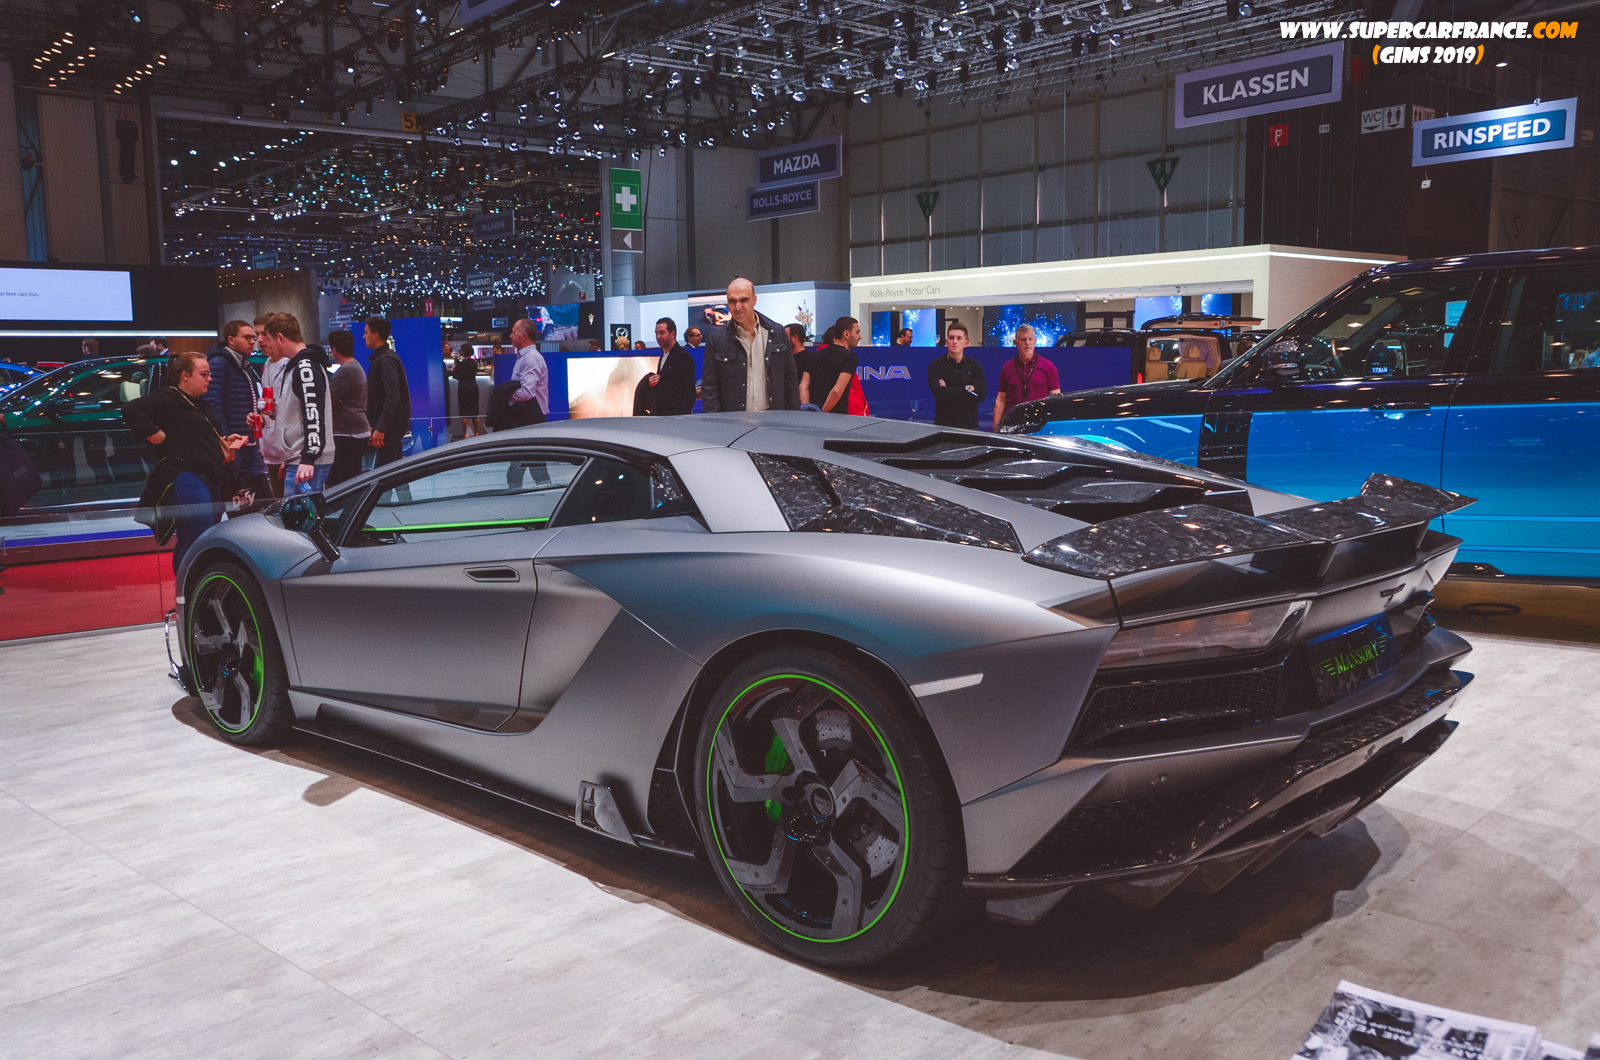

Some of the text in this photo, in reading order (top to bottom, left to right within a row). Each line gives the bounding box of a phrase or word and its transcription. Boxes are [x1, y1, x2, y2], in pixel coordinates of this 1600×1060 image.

[1203, 67, 1309, 105] KLASSEN
[1363, 111, 1382, 123] WC
[1433, 118, 1551, 150] RINSPEED
[773, 153, 820, 175] MAZDA
[753, 190, 812, 208] ROLLS-ROYCE
[481, 220, 505, 231] McLAREN
[469, 278, 491, 286] MASERATI
[870, 285, 941, 299] Rolls-Royce Motor Cars
[856, 366, 912, 380] INA
[1334, 640, 1379, 674] MANSORY
